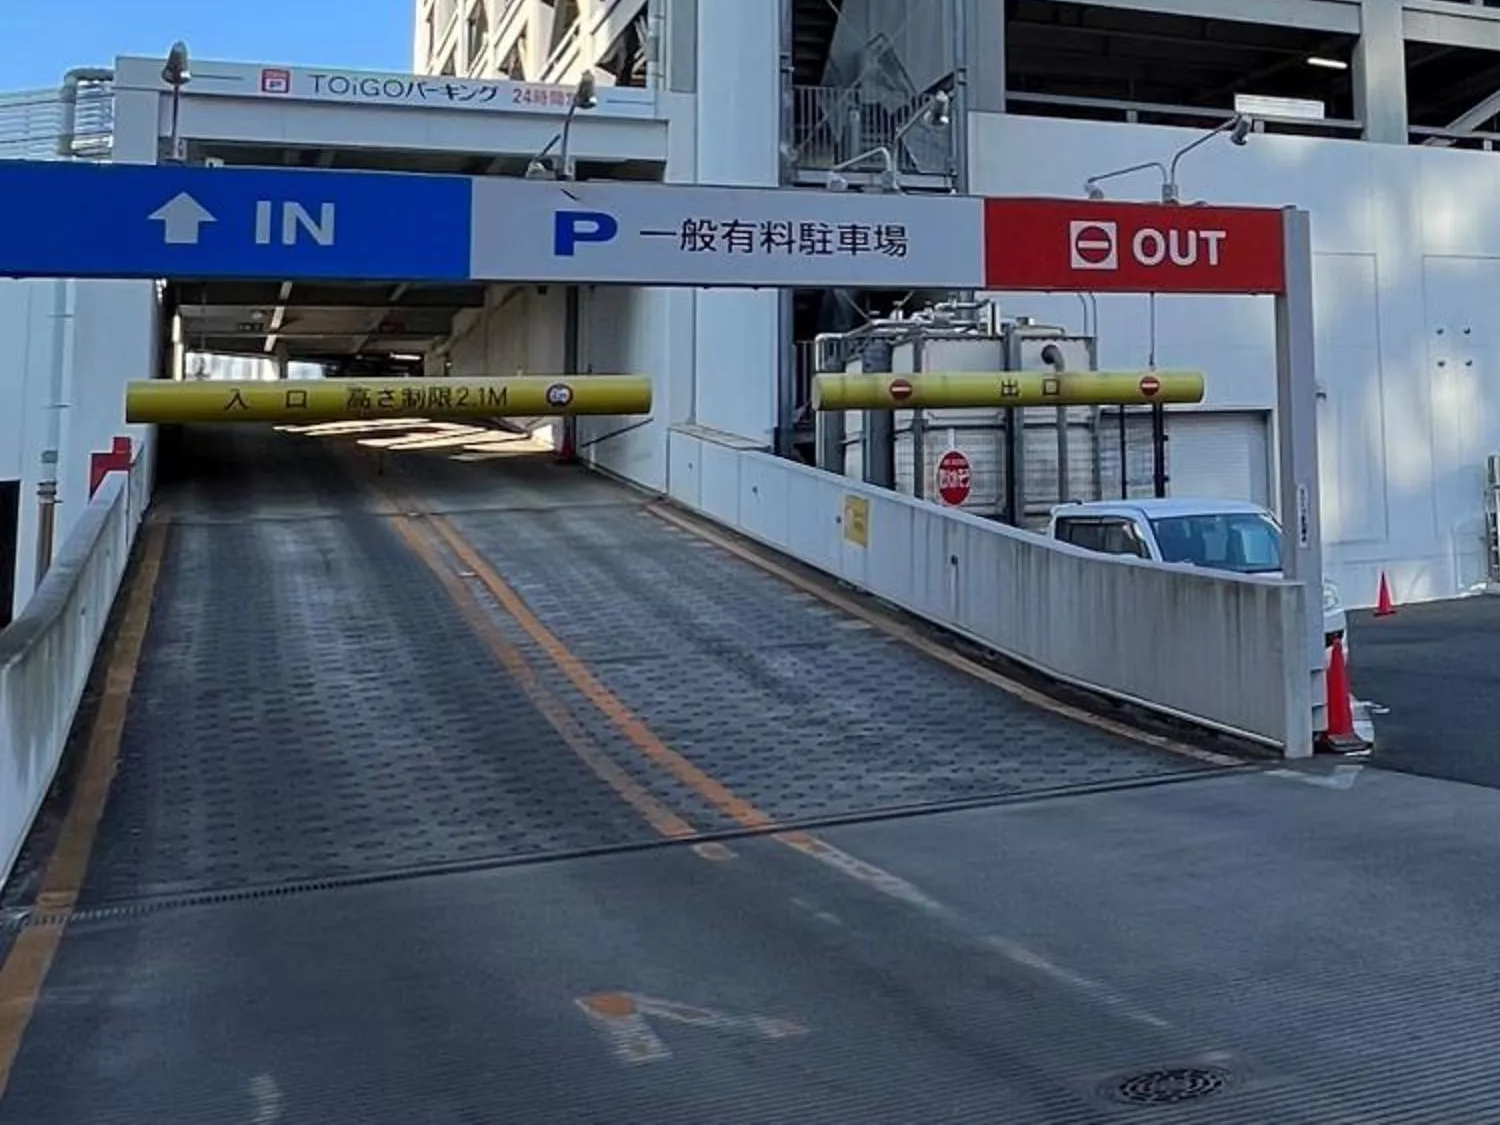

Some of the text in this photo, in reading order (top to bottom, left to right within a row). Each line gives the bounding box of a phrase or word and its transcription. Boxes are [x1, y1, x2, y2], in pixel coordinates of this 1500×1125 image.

[255, 200, 335, 246] IN
[553, 211, 619, 256] P
[640, 217, 909, 259] 一般有料駐車場
[1132, 228, 1227, 266] OUT
